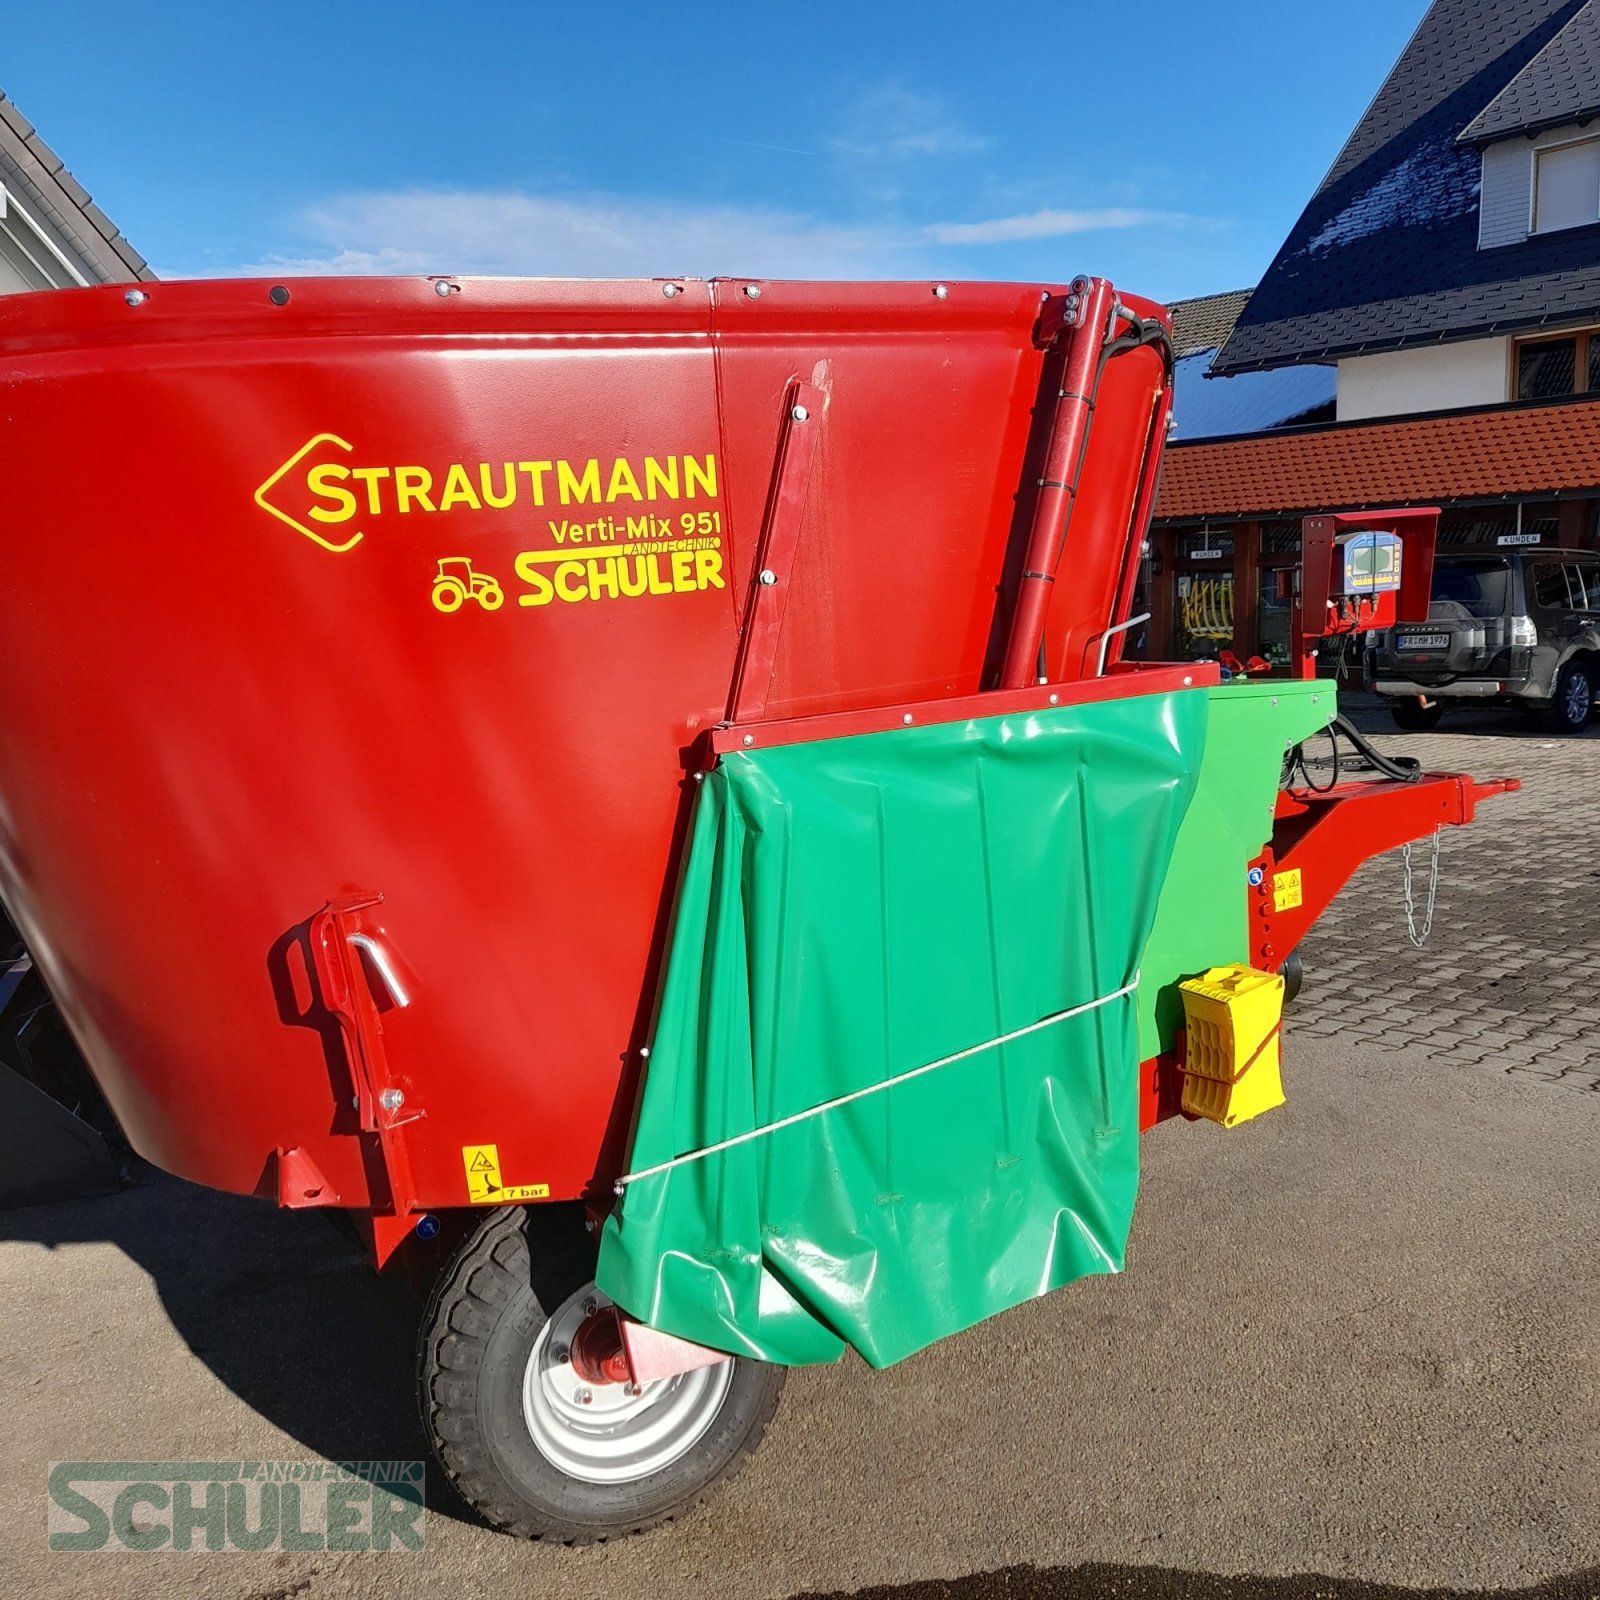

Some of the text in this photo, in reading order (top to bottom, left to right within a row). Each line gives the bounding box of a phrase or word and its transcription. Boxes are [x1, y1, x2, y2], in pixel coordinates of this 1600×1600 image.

[306, 453, 719, 524] STRAUTMANN
[548, 511, 721, 544] Verti-Mix 951
[1503, 535, 1538, 544] KUNDEN
[621, 536, 718, 557] LANDTECHNIK
[514, 537, 726, 607] SCHULER
[507, 1187, 545, 1198] 7 bar
